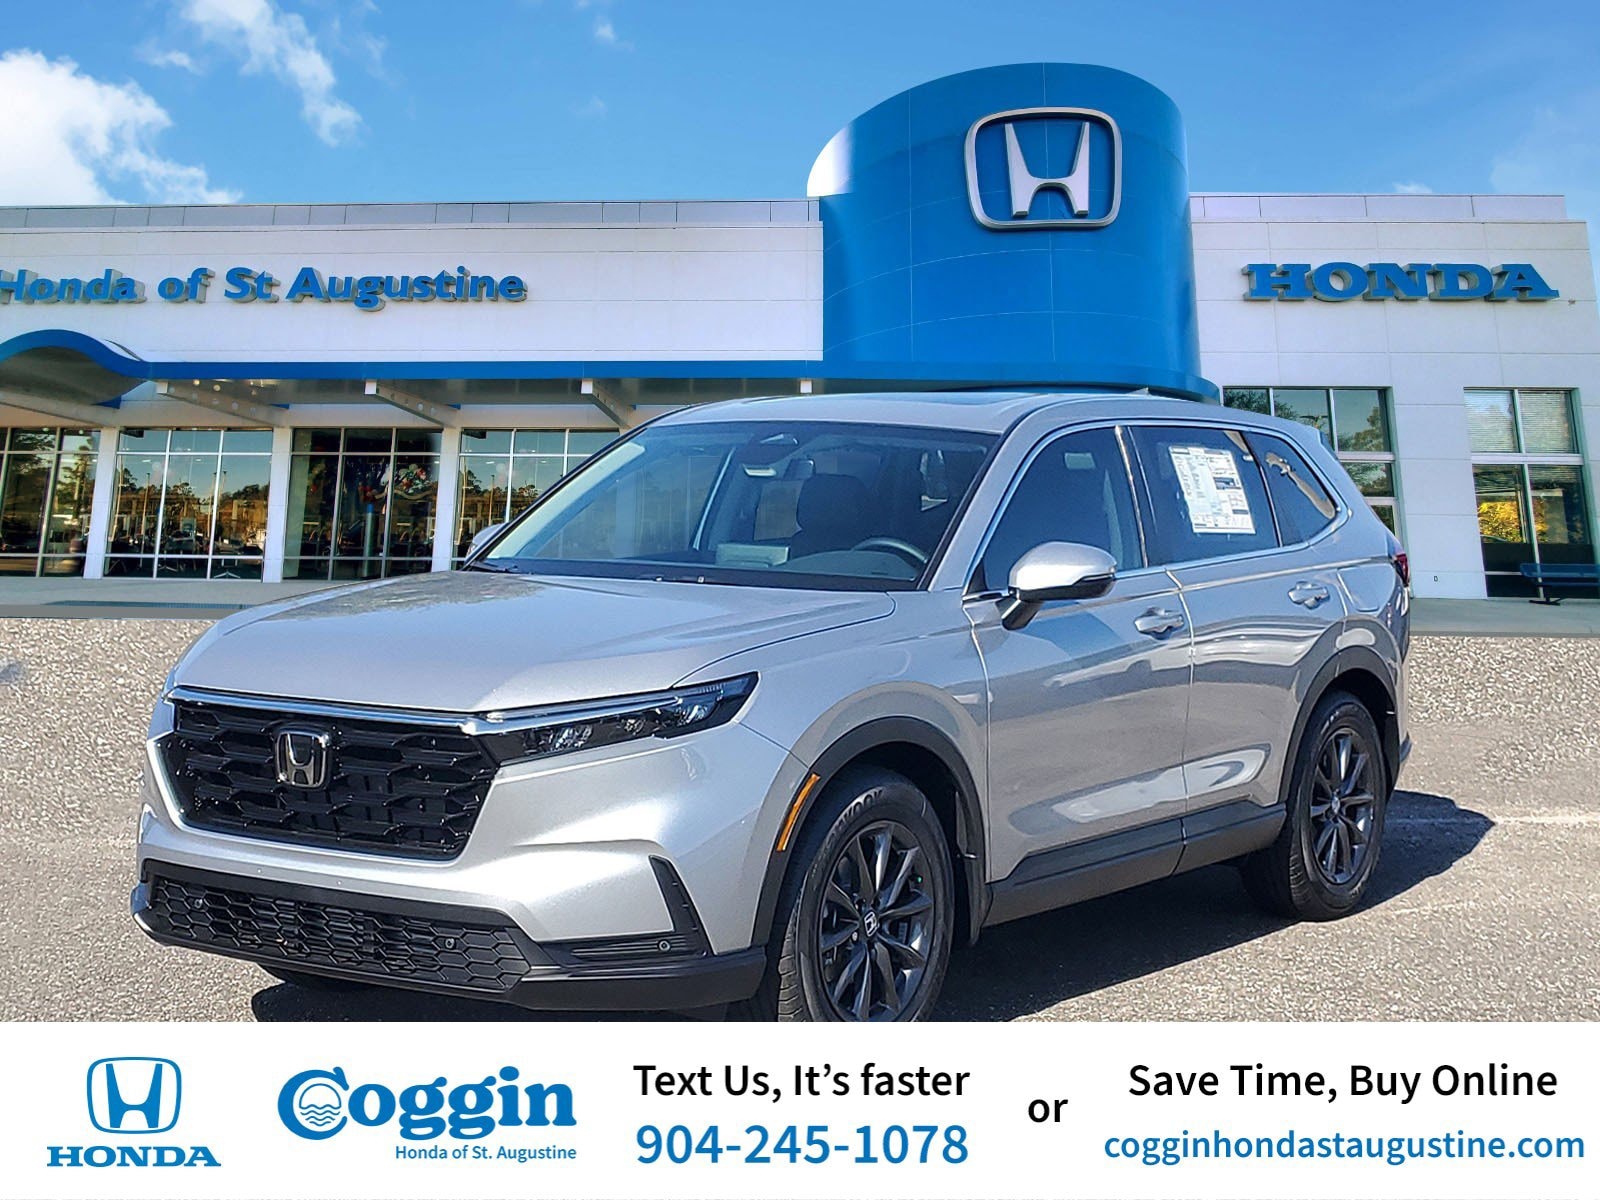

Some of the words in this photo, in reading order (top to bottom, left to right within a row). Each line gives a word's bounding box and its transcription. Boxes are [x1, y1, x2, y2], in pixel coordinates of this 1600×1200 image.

[0, 268, 142, 303] Honda
[157, 267, 213, 302] of
[224, 266, 277, 302] St
[286, 265, 526, 310] Augustine
[1243, 261, 1560, 301] HONDA
